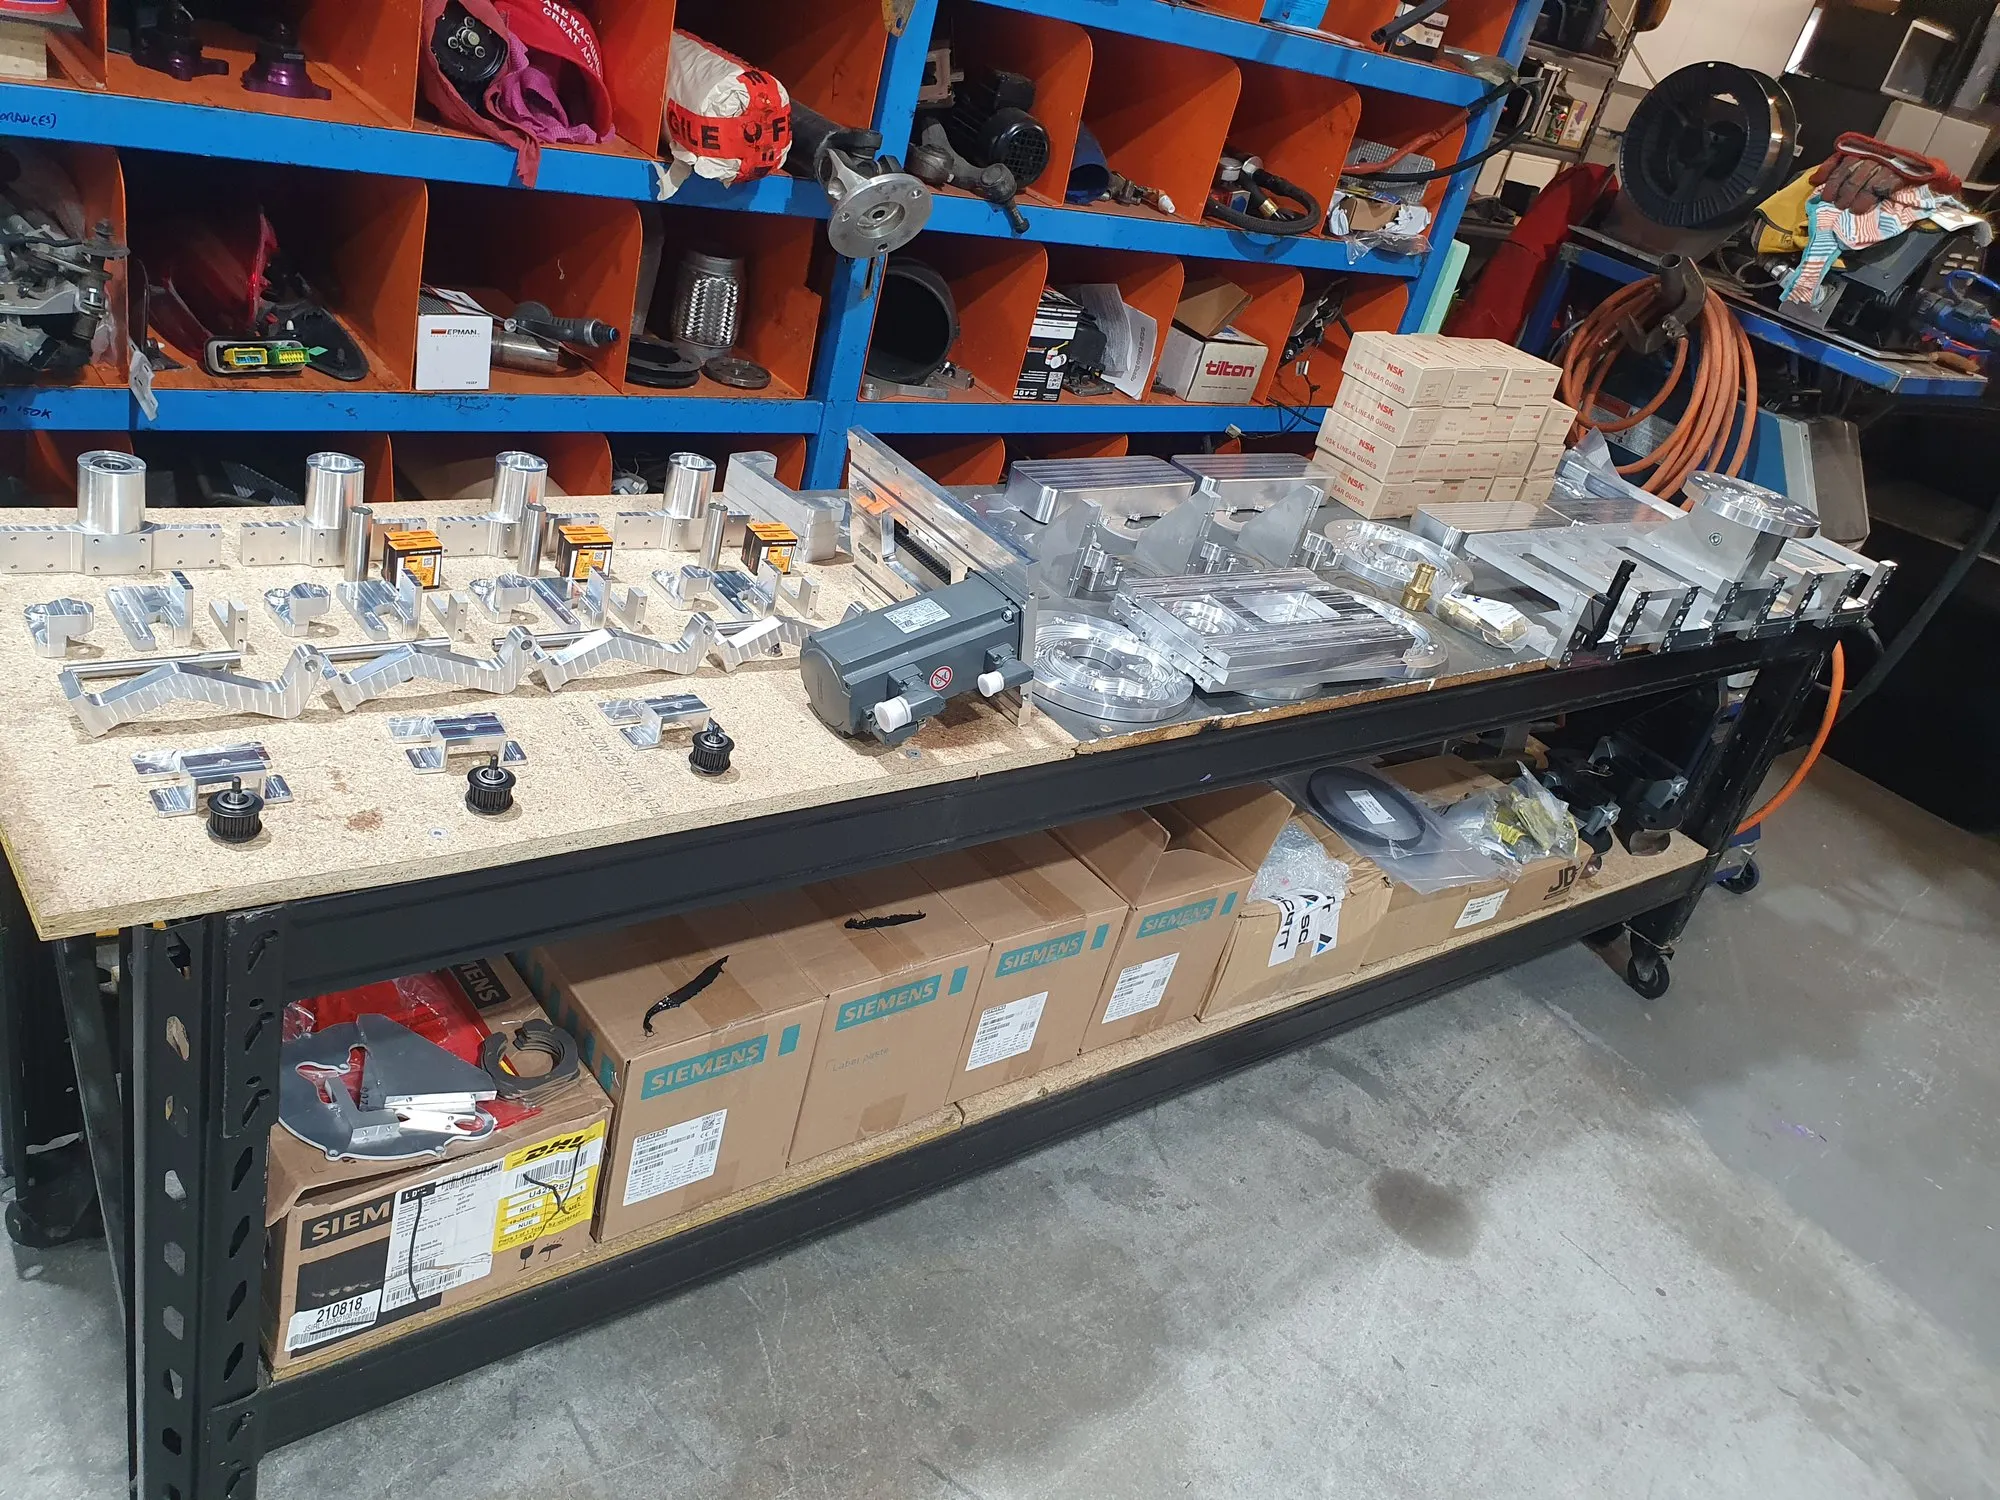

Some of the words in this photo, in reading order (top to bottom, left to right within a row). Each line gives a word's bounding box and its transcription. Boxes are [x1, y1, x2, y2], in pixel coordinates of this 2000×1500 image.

[542, 0, 569, 19] AKE
[543, 7, 580, 45] GREAT
[447, 328, 477, 336] EPMAN
[1206, 360, 1256, 378] tilton
[1353, 361, 1363, 372] NSK
[1364, 367, 1385, 384] LINEAR
[1384, 379, 1405, 394] GUIDES
[1386, 363, 1404, 378] NSK
[1342, 400, 1354, 410] NSK
[1355, 407, 1375, 421] LINEAR
[1375, 418, 1396, 433] GUIDES
[1377, 401, 1394, 417] NSK
[1325, 436, 1336, 446] NSK
[1336, 443, 1357, 458] LINEAR
[1356, 455, 1377, 470] GUIDES
[1358, 439, 1376, 454] NSK
[1347, 476, 1365, 491] NSK
[1345, 491, 1365, 507] GUIDES
[1144, 903, 1211, 933] SIEMENS
[1002, 937, 1080, 971] SIEMENS
[844, 981, 936, 1024] SIEMENS
[651, 1042, 761, 1092] SIEMENS
[525, 1135, 586, 1162] DHL
[315, 1297, 363, 1323] 210818
